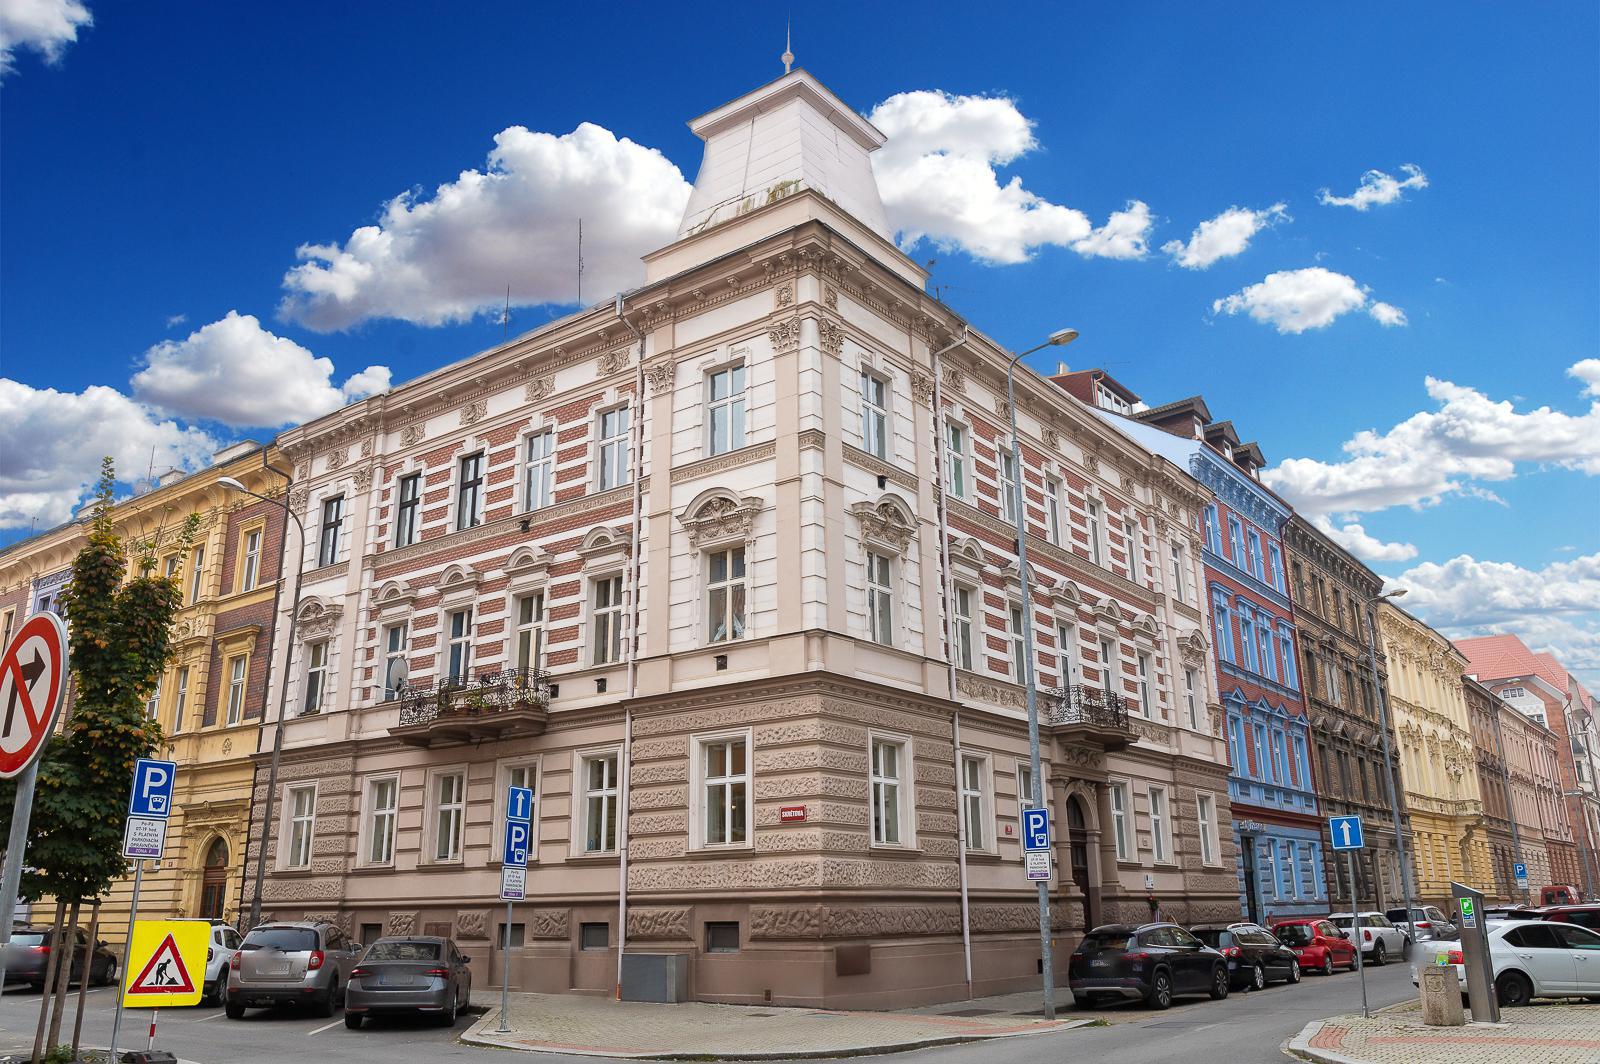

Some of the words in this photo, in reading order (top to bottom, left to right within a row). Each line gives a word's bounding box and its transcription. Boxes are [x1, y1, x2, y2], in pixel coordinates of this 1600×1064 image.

[142, 767, 167, 798] P
[1029, 814, 1044, 838] P
[510, 826, 525, 851] P
[1516, 865, 1523, 874] P
